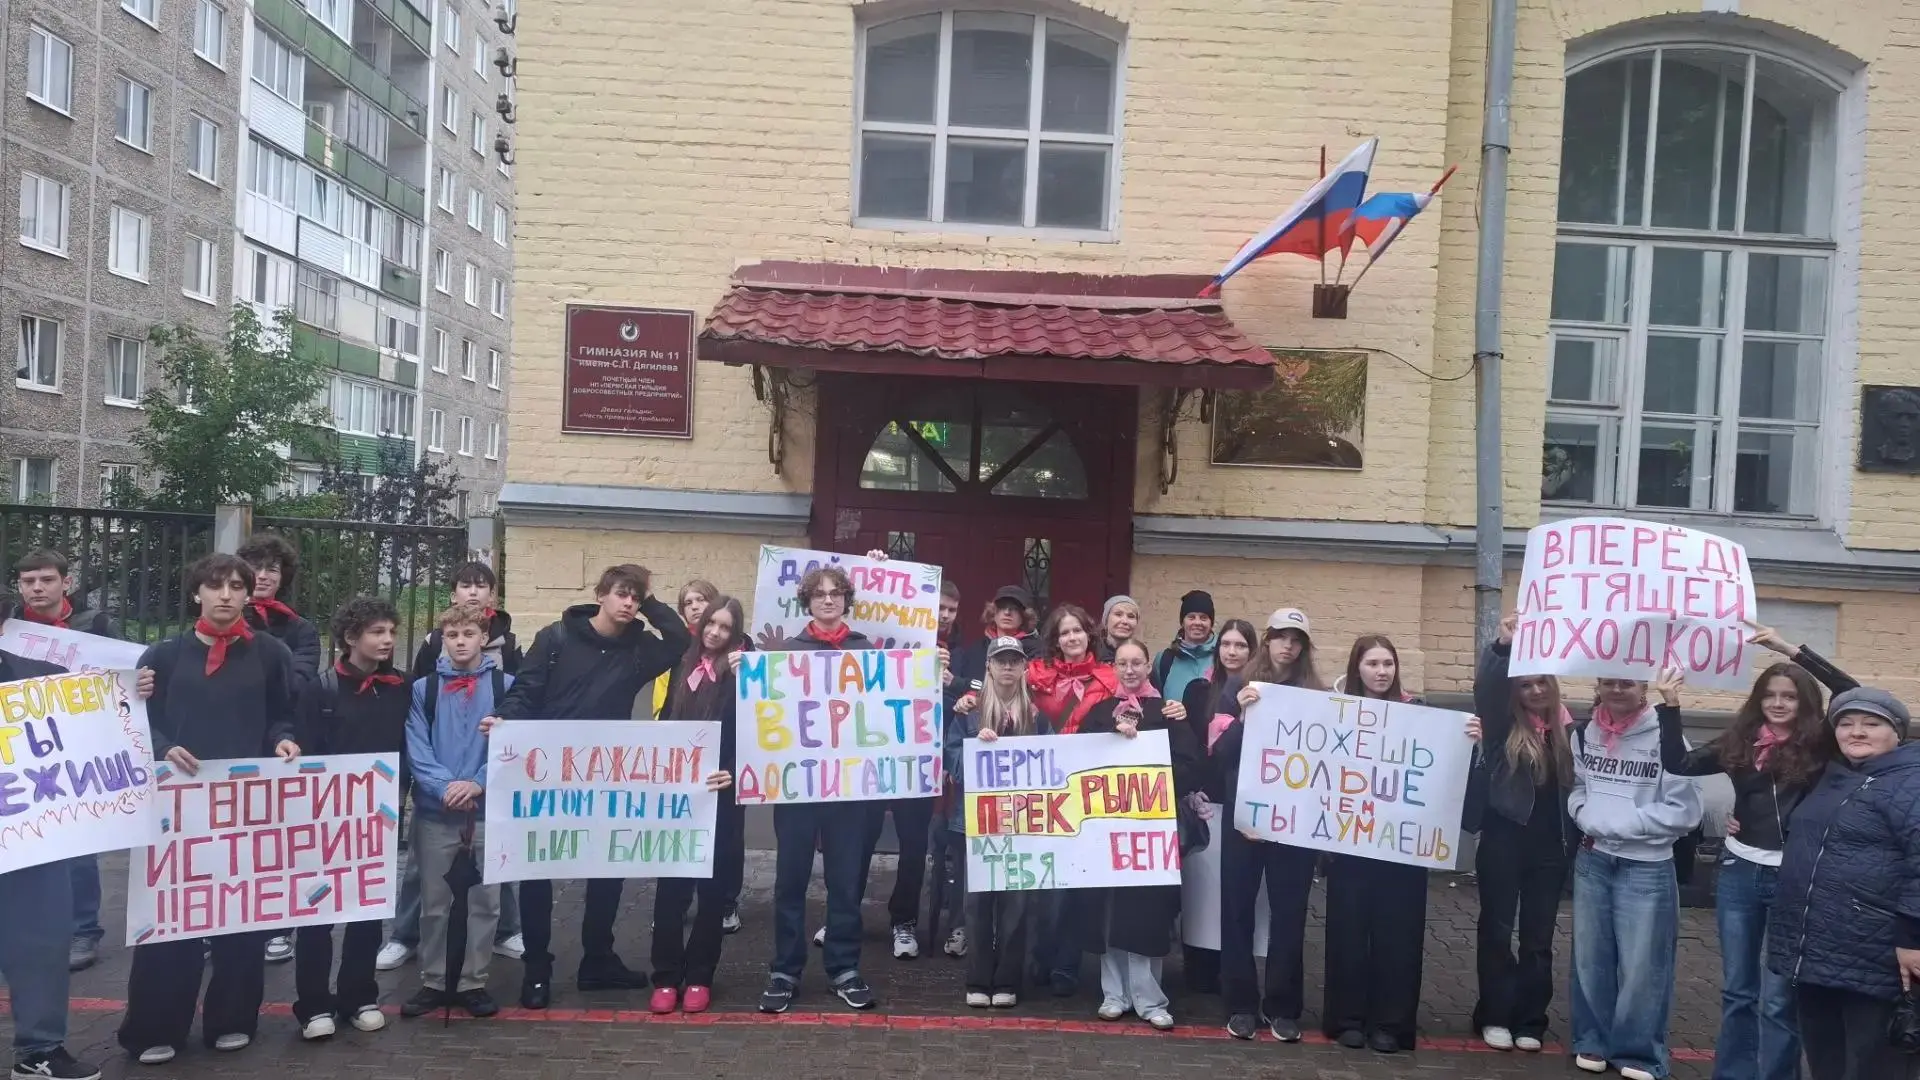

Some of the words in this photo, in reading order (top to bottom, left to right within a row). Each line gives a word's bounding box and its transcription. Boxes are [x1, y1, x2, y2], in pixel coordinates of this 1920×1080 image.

[579, 346, 647, 358] ГИМНАЗИЯ
[650, 350, 664, 359] №
[667, 351, 679, 360] 11
[579, 360, 610, 368] имени
[611, 360, 631, 369] С.П.
[633, 361, 678, 372] Дягилева
[1543, 524, 1742, 580] ВПЕРЁД!
[850, 566, 917, 600] ПЯТЬ
[1518, 571, 1745, 622] ЛЕТЯЩЕЙ
[1517, 617, 1744, 677] ПОХОДКОЙ
[755, 698, 941, 751] ВЕРЬТЕ!
[1329, 696, 1389, 728] ТЫ
[1276, 718, 1434, 769] МОЖЕШЬ
[525, 747, 548, 782] С
[562, 745, 706, 784] КАЖДЫМ
[736, 755, 942, 804] ДОСТИГАЙТЕ!
[975, 748, 1067, 789] ПЕРМЬ
[1261, 748, 1426, 807] БОЛЬШЕ
[1620, 759, 1660, 778] YOUNG
[157, 770, 376, 833] ТВОРИМ
[600, 789, 646, 819] ТЫ
[657, 791, 692, 819] НА
[1319, 795, 1376, 817] ЧЕМ
[146, 814, 384, 888] ИСТОРИЮ
[607, 828, 711, 863] БЛИЖЕ
[1109, 830, 1183, 871] БЕГИ
[1245, 801, 1297, 834] ТЫ
[1311, 810, 1451, 862] ДУМАЕШЬ
